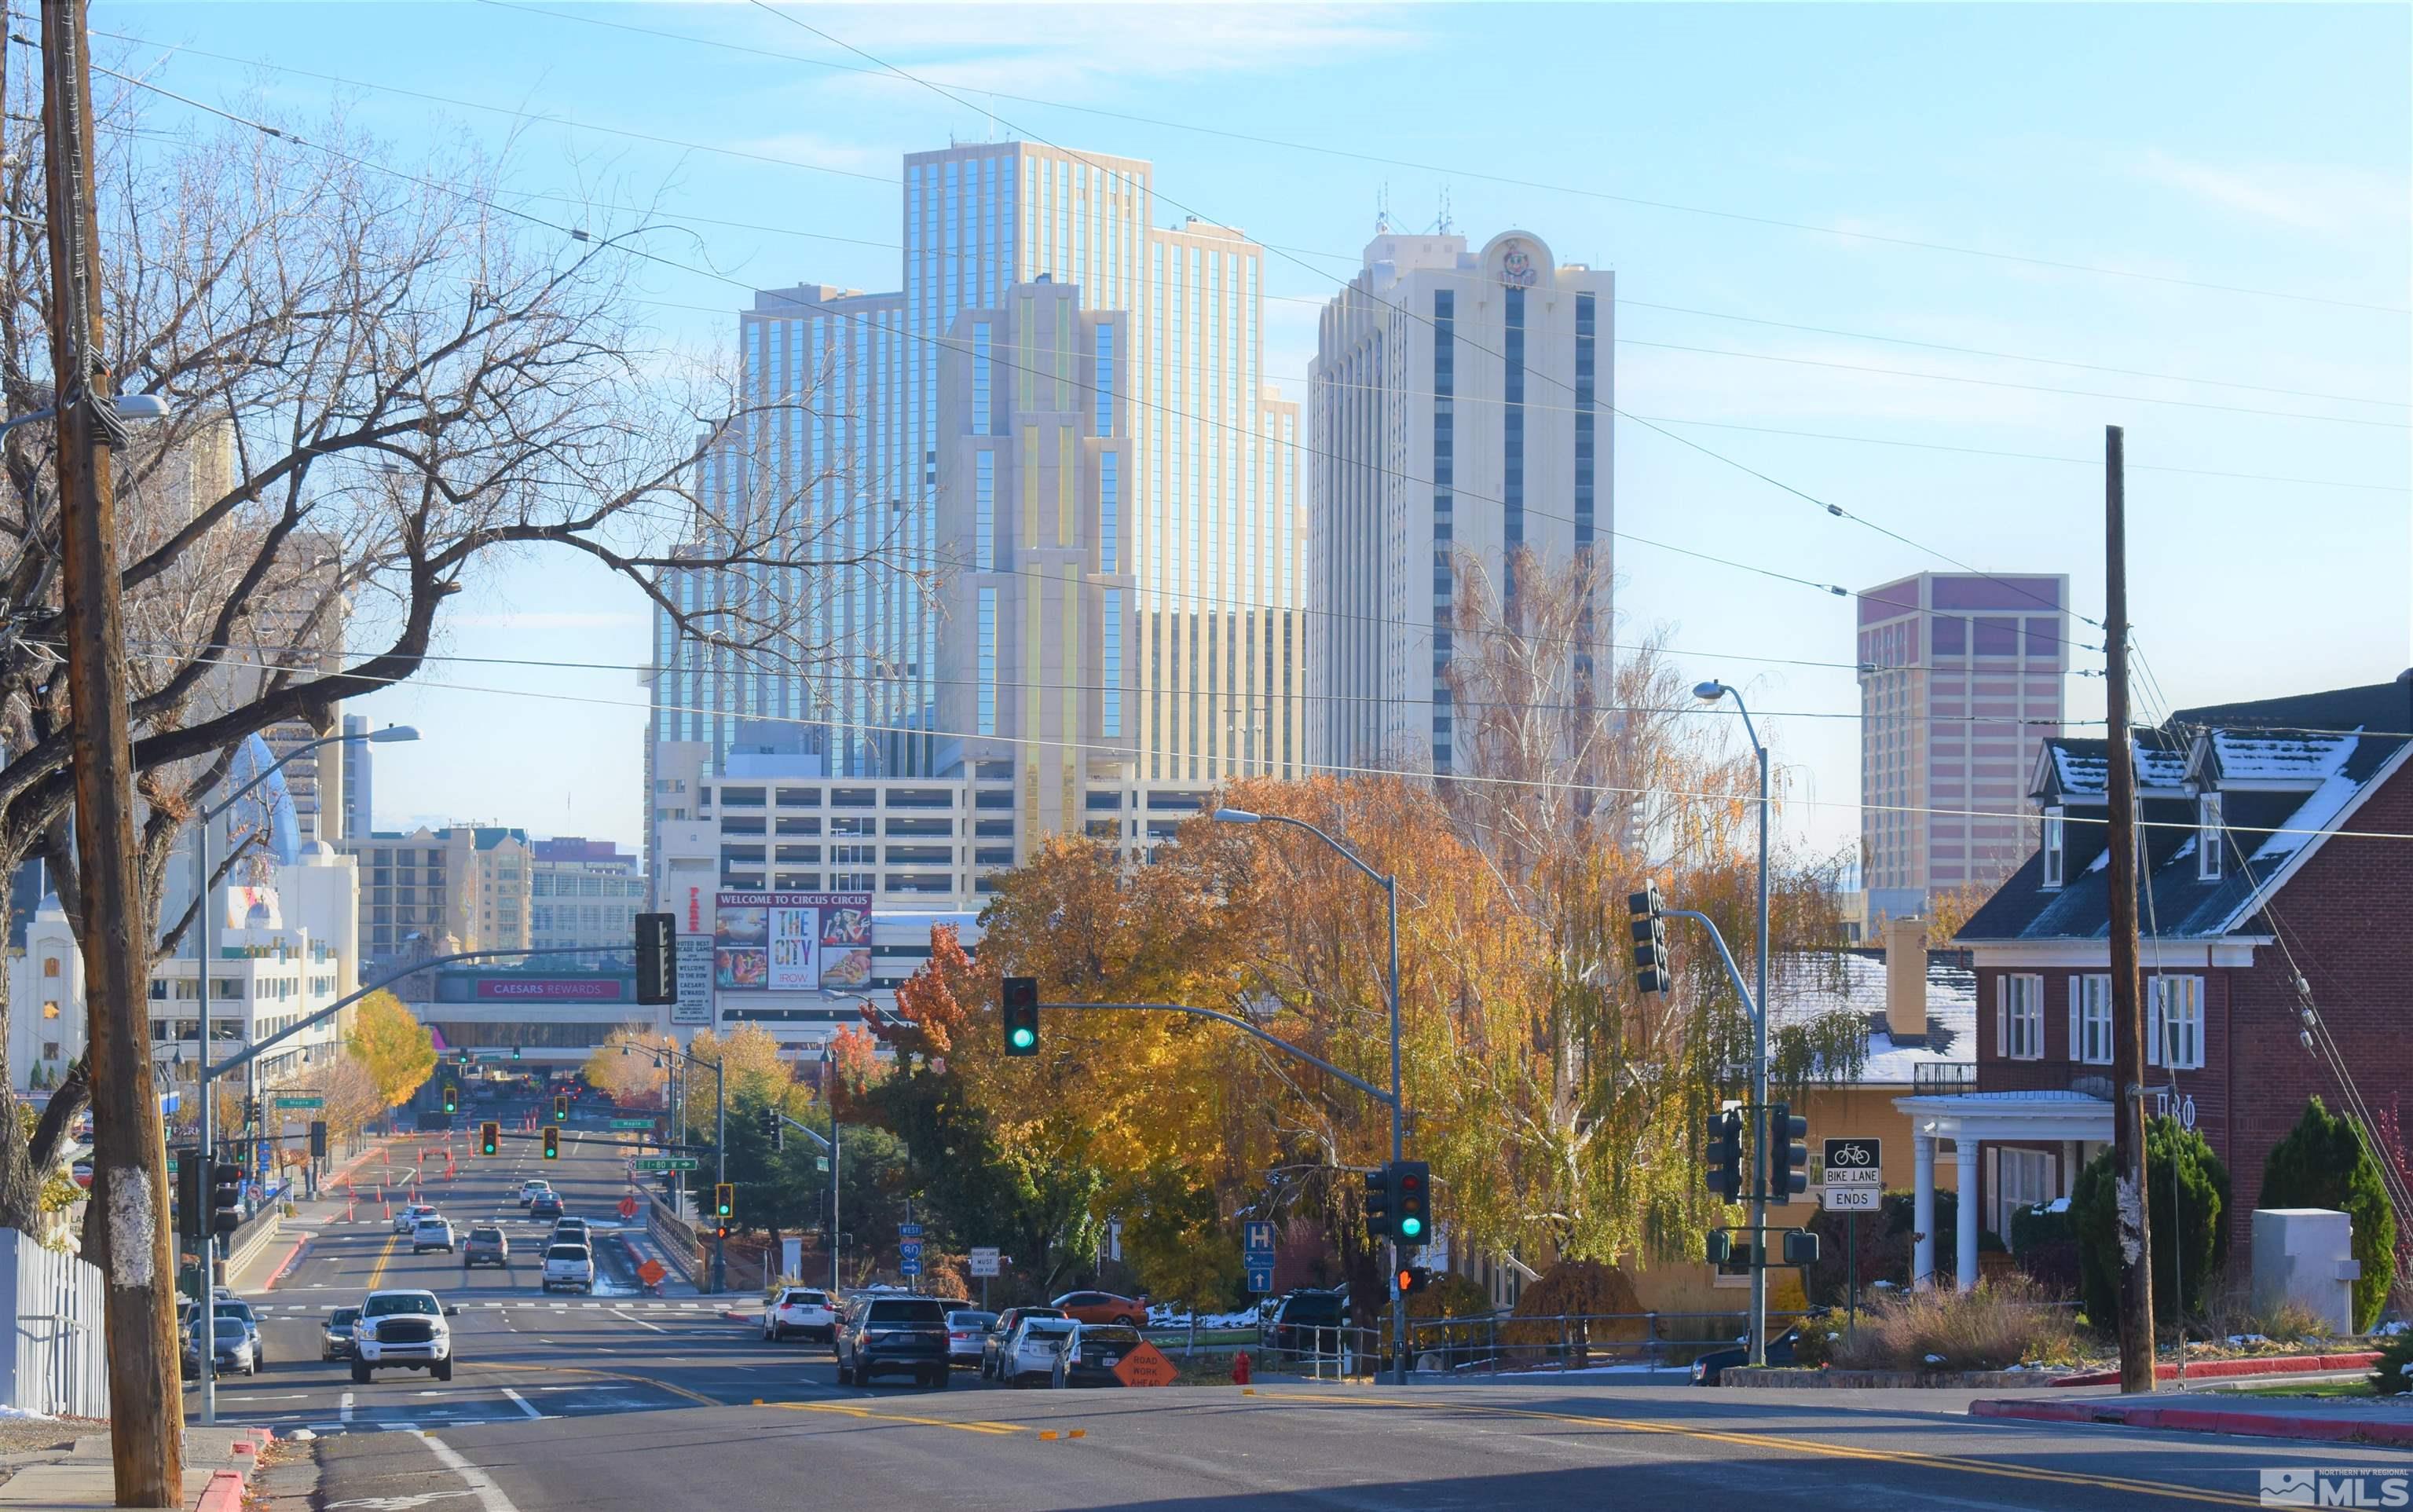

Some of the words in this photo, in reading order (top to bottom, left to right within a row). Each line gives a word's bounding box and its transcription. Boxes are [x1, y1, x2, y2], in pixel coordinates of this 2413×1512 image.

[721, 895, 771, 904] WELCOME
[775, 895, 788, 904] TO
[792, 895, 828, 904] CIRCUS
[831, 895, 868, 904] CIRCUS
[778, 911, 809, 937] THE
[774, 939, 813, 966] CITY
[493, 984, 544, 994] CAESARS
[547, 985, 601, 994] REWARDS
[1827, 1170, 1847, 1181] BIKE
[1851, 1170, 1877, 1181] LANE
[1836, 1193, 1868, 1204] ENDS
[1250, 1226, 1269, 1248] H
[904, 1245, 918, 1255] 80
